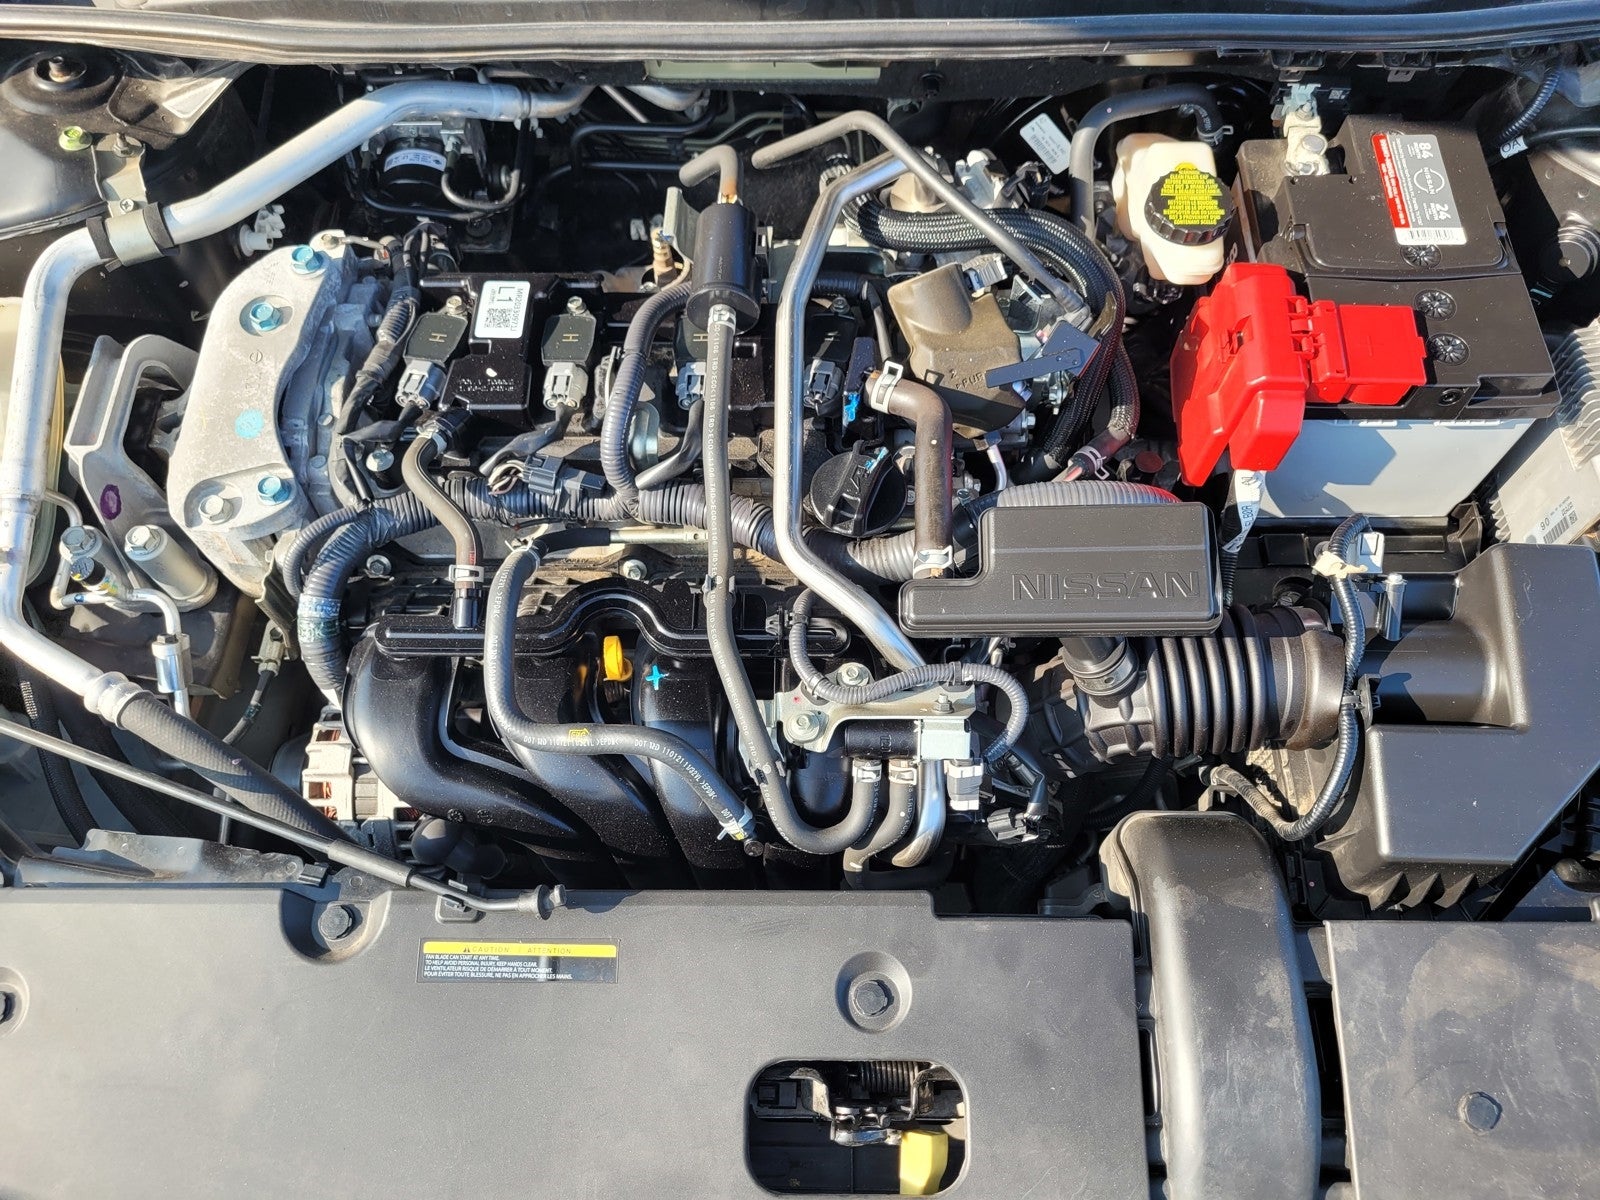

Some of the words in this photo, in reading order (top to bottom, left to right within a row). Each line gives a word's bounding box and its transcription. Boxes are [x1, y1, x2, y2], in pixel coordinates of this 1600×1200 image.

[1423, 167, 1436, 195] NISSAN
[1012, 571, 1200, 600] NISSAN
[634, 739, 647, 747] DOT
